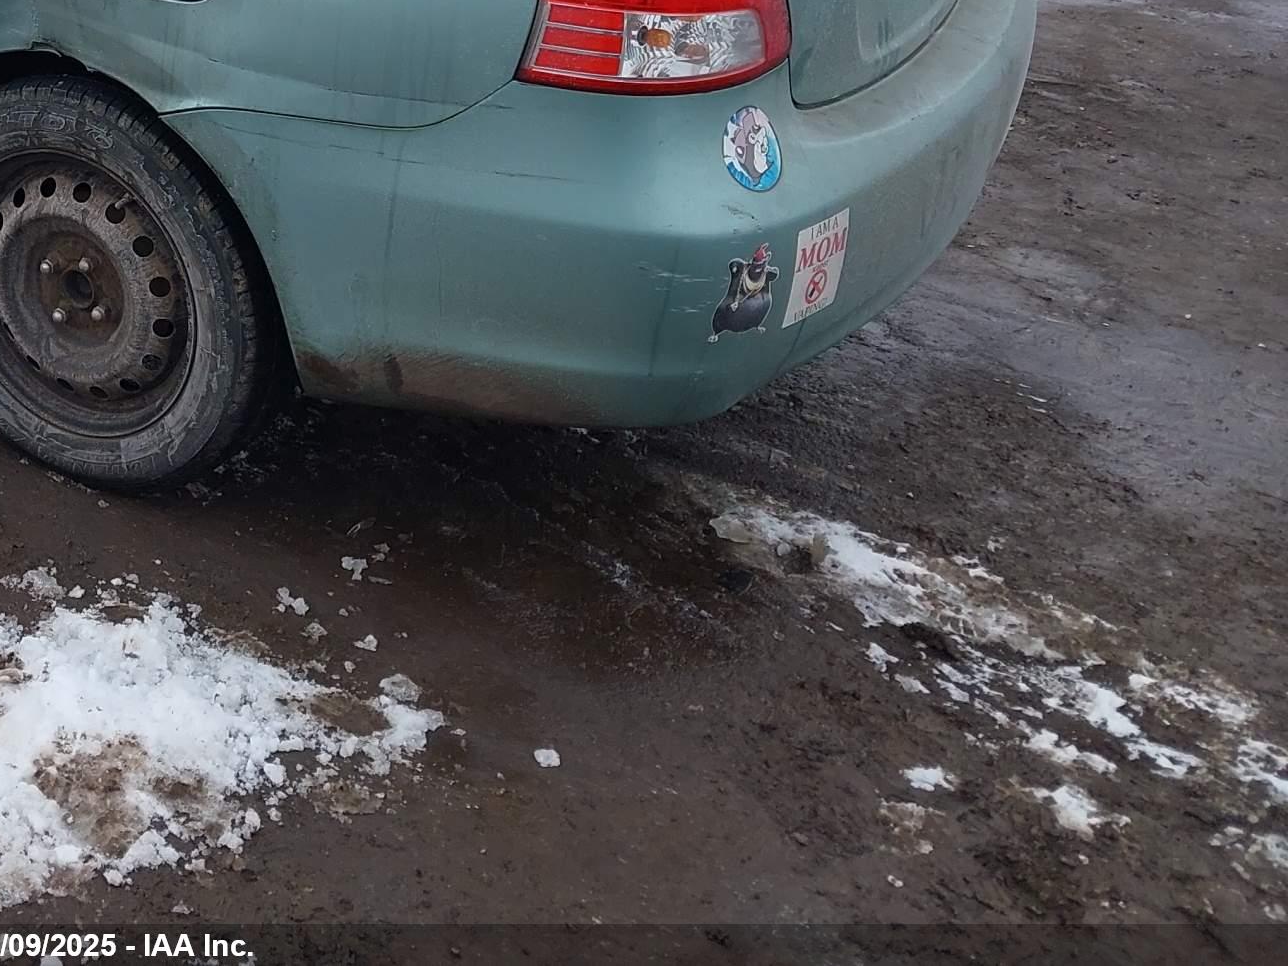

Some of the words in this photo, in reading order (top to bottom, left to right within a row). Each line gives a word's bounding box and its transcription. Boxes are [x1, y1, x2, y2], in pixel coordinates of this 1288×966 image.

[817, 221, 831, 237] AM
[833, 216, 839, 229] A
[796, 227, 847, 273] MOM
